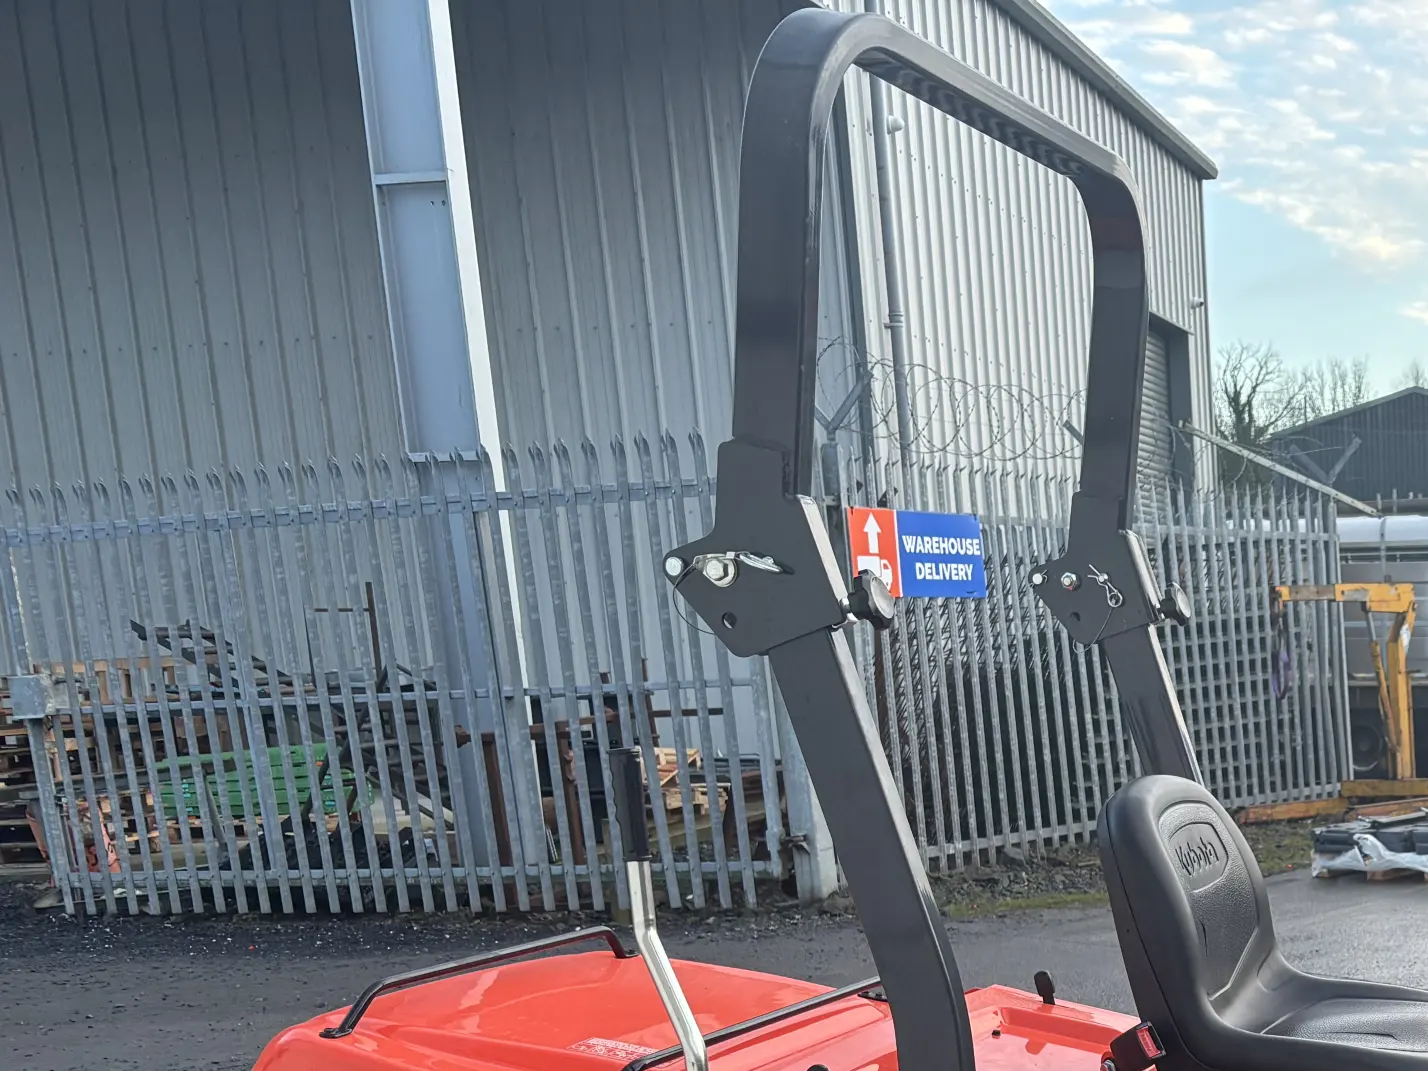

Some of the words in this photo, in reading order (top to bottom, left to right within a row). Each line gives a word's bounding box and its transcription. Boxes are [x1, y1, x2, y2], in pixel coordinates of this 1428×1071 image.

[902, 535, 981, 556] WAREHOUSE
[915, 562, 973, 581] DELIVERY
[1175, 836, 1219, 876] Kubota
